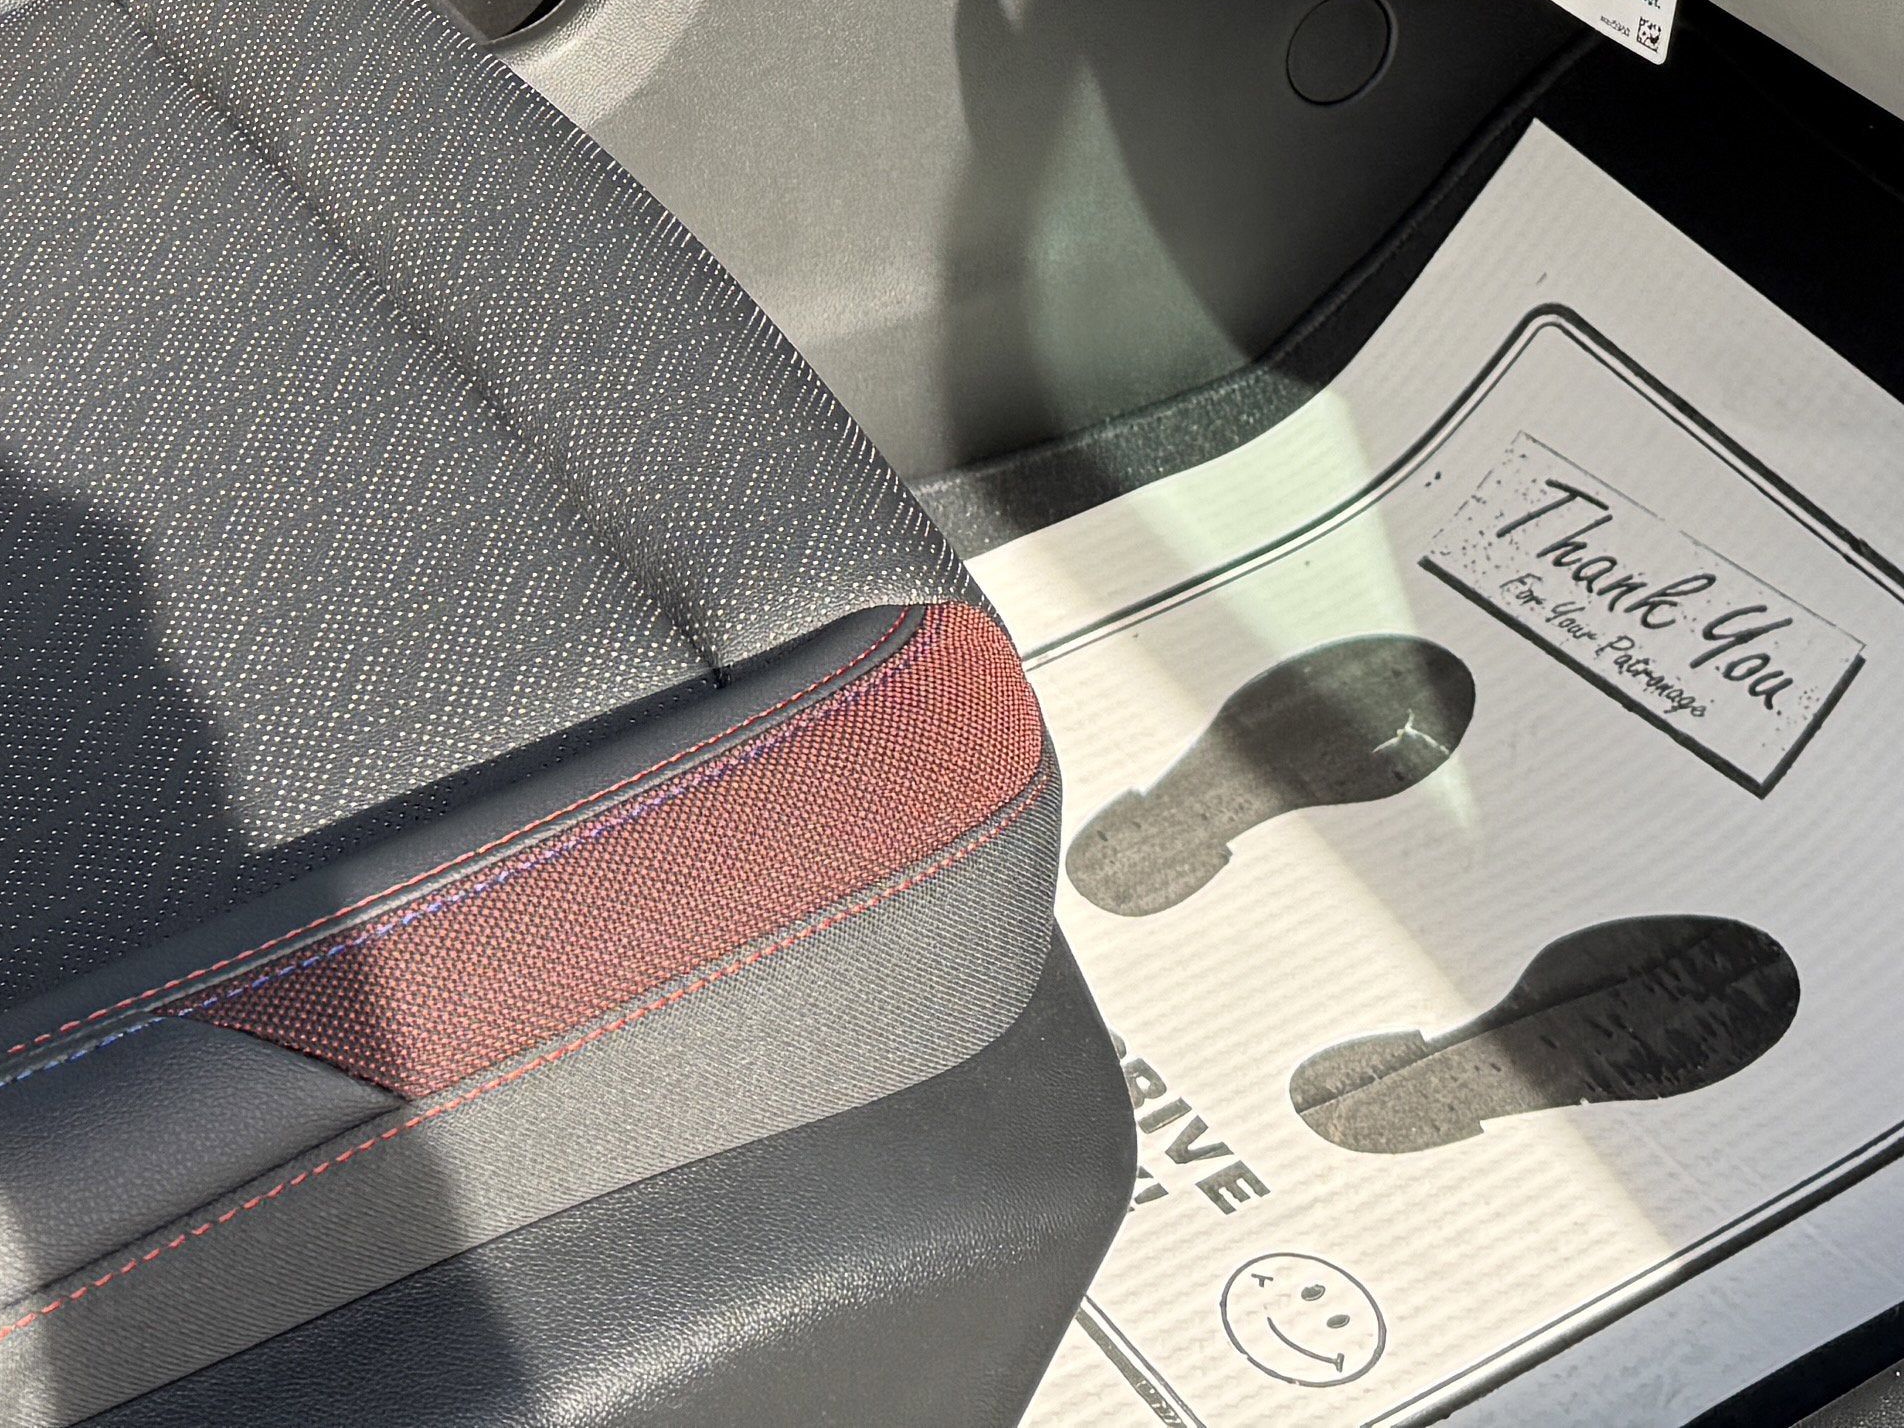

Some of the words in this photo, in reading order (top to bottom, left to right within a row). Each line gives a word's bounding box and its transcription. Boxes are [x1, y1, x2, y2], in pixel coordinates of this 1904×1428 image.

[1496, 478, 1715, 630] Thank
[1690, 604, 1794, 710] You
[1498, 573, 1544, 610] For
[1539, 598, 1598, 643] Your
[1598, 634, 1715, 719] Patronage
[1109, 1030, 1272, 1215] RIVE
